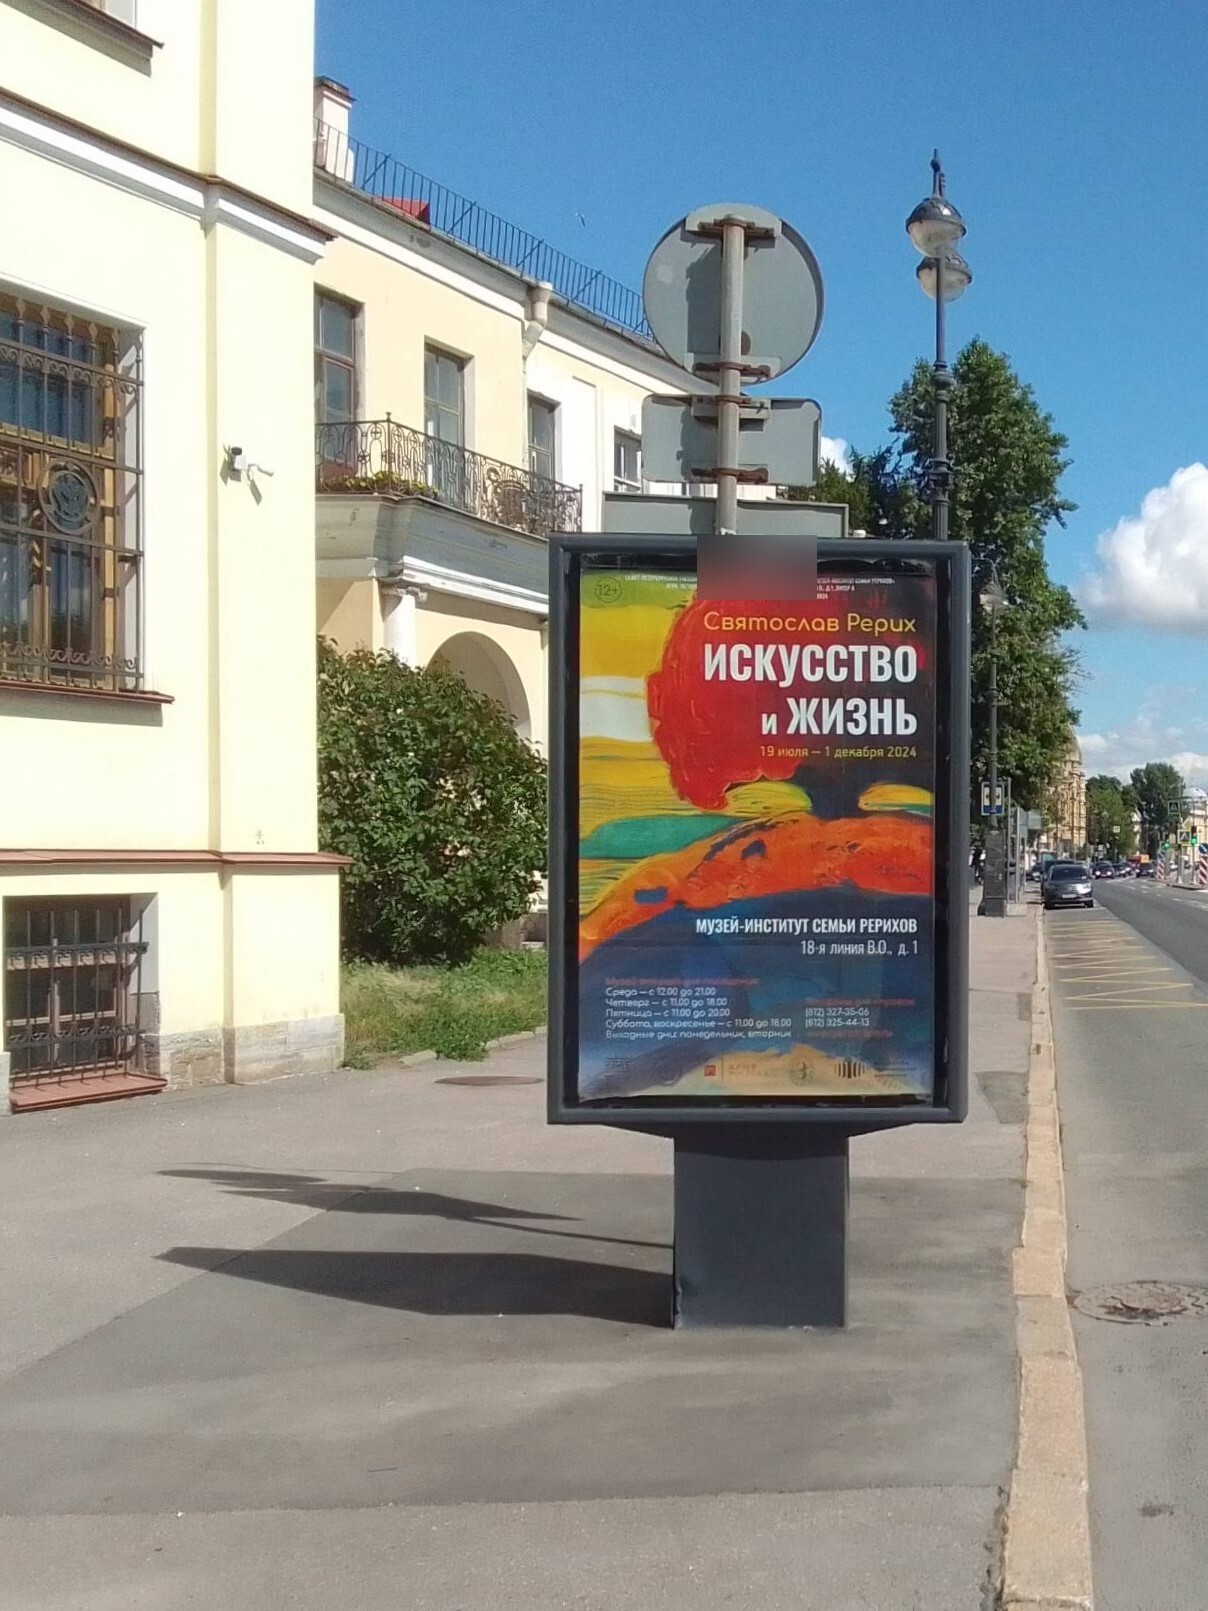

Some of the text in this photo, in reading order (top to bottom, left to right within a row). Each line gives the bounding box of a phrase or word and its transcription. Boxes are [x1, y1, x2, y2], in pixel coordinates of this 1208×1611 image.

[597, 584, 619, 596] 12+
[703, 611, 916, 637] Святослав Рерих
[704, 643, 917, 688] ИСКУССТВО
[761, 697, 918, 735] и ЖИЗНЬ
[760, 745, 774, 757] 19
[778, 746, 809, 757] июля
[825, 745, 830, 757] 1
[834, 745, 884, 760] декабря
[887, 746, 917, 758] 2024
[696, 916, 918, 935] МУЗЕЙ-ИНСТИТУТ СЕМЬИ РЕРИХОВ
[801, 940, 826, 955] 18-я
[829, 942, 864, 955] линия
[897, 942, 909, 956] д.
[912, 940, 918, 954] 1
[605, 987, 638, 998] Среда
[656, 987, 678, 996] 12.00
[694, 987, 716, 996] 21.00
[605, 998, 650, 1008] Четверг
[605, 1008, 653, 1018] Пятница
[734, 1018, 754, 1027] 11.00
